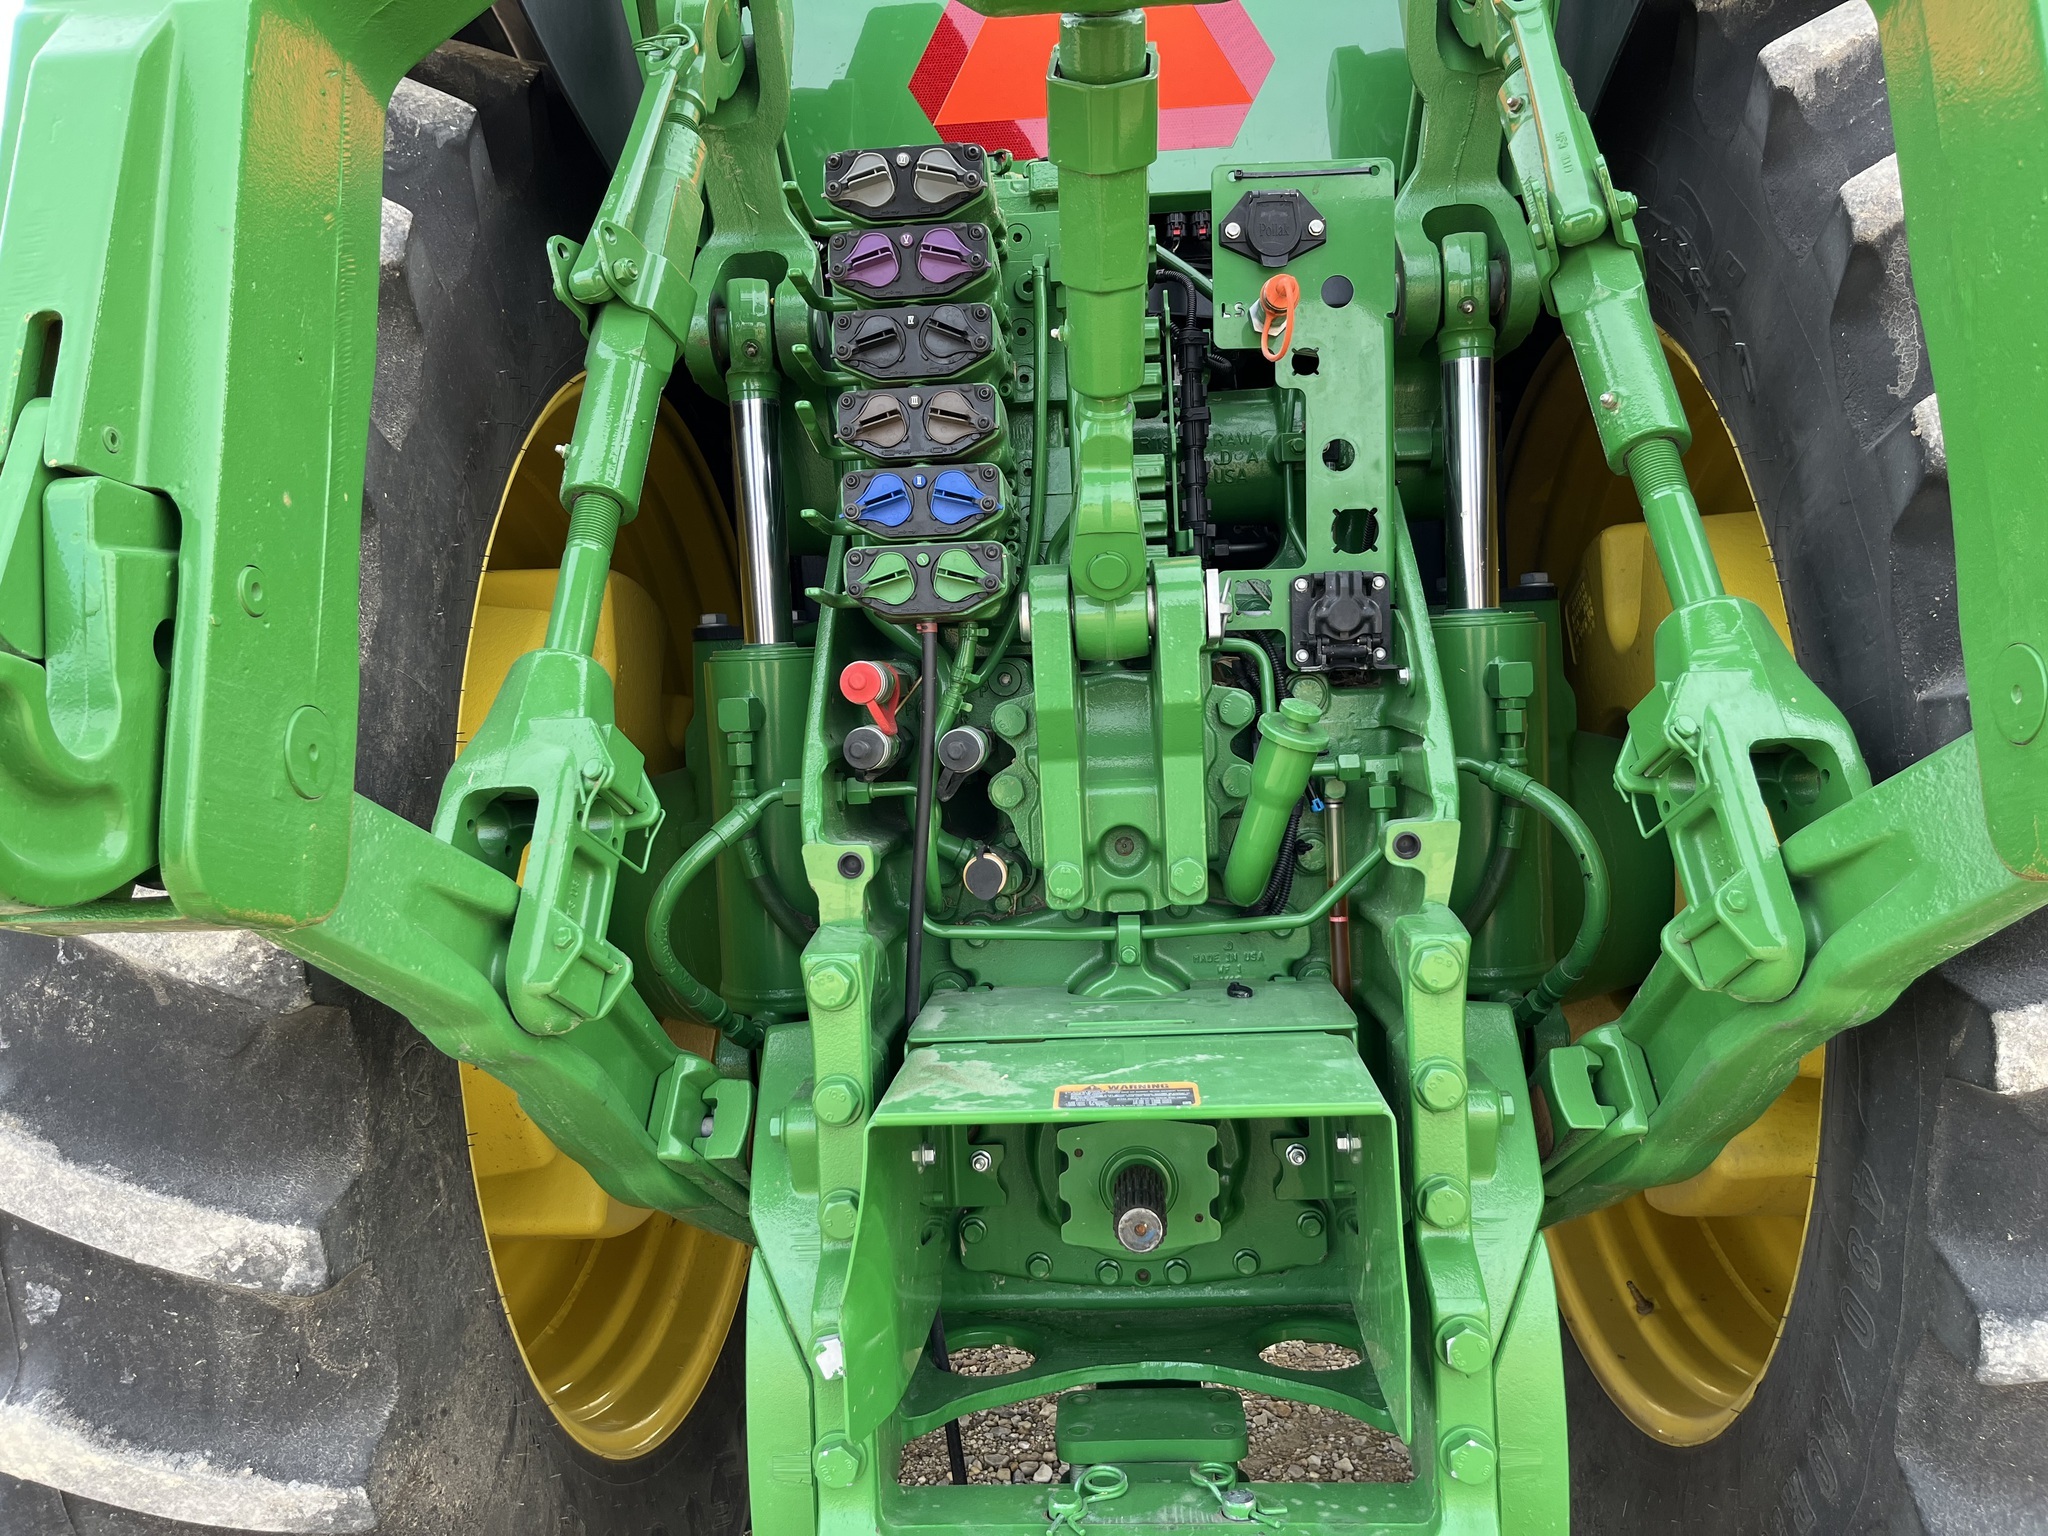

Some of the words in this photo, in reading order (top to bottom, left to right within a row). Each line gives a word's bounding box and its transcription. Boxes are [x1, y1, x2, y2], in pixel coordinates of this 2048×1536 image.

[1259, 223, 1289, 237] Pollak
[910, 396, 919, 405] III
[1213, 432, 1252, 447] RAW
[1213, 467, 1247, 484] USA
[1193, 953, 1220, 964] MADE
[1226, 952, 1238, 963] IN
[1244, 950, 1265, 962] USA
[1108, 1083, 1170, 1091] WARNING
